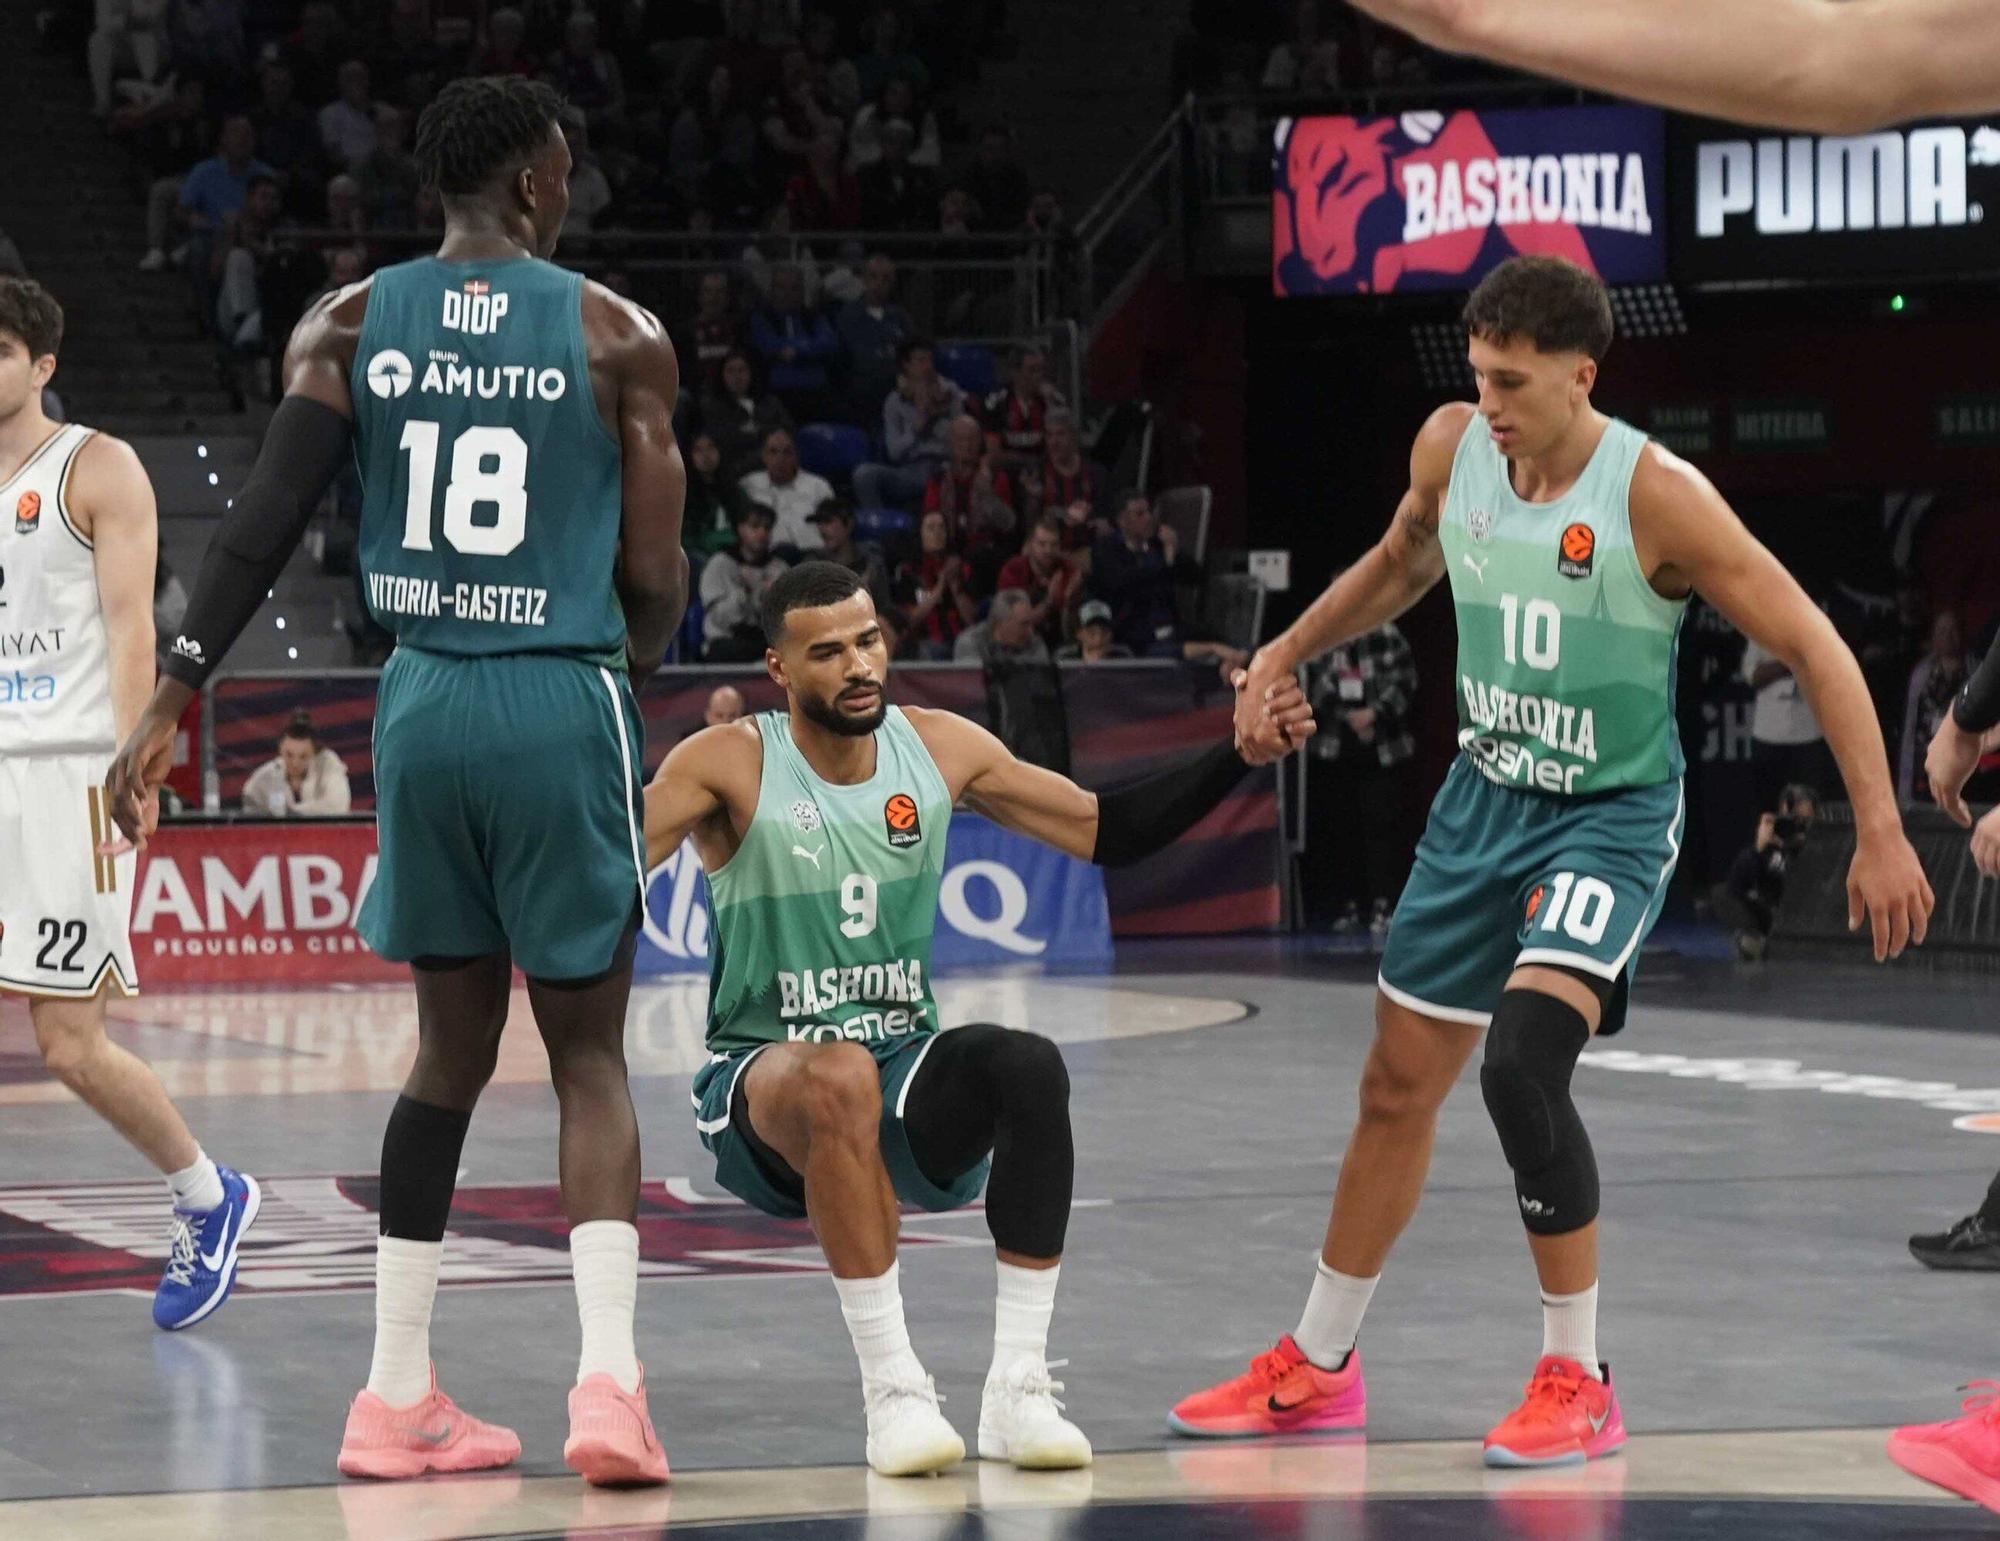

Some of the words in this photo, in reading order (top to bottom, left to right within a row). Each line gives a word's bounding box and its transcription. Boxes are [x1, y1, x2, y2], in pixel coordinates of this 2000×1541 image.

[1402, 152, 1652, 243] BASKONIA
[1696, 127, 1967, 237] PUMA
[442, 289, 508, 335] DIOP
[420, 361, 566, 401] AMUTIO
[429, 349, 459, 364] GRUPO
[400, 420, 528, 556] 18
[369, 572, 548, 626] VITORIA-GASTEIZ
[1499, 593, 1561, 671] 10
[1462, 673, 1597, 763] BASKONIA
[840, 872, 878, 939] 9
[1540, 871, 1616, 946] 10
[36, 917, 87, 972] 22
[153, 935, 294, 956] PEQUEÑOS
